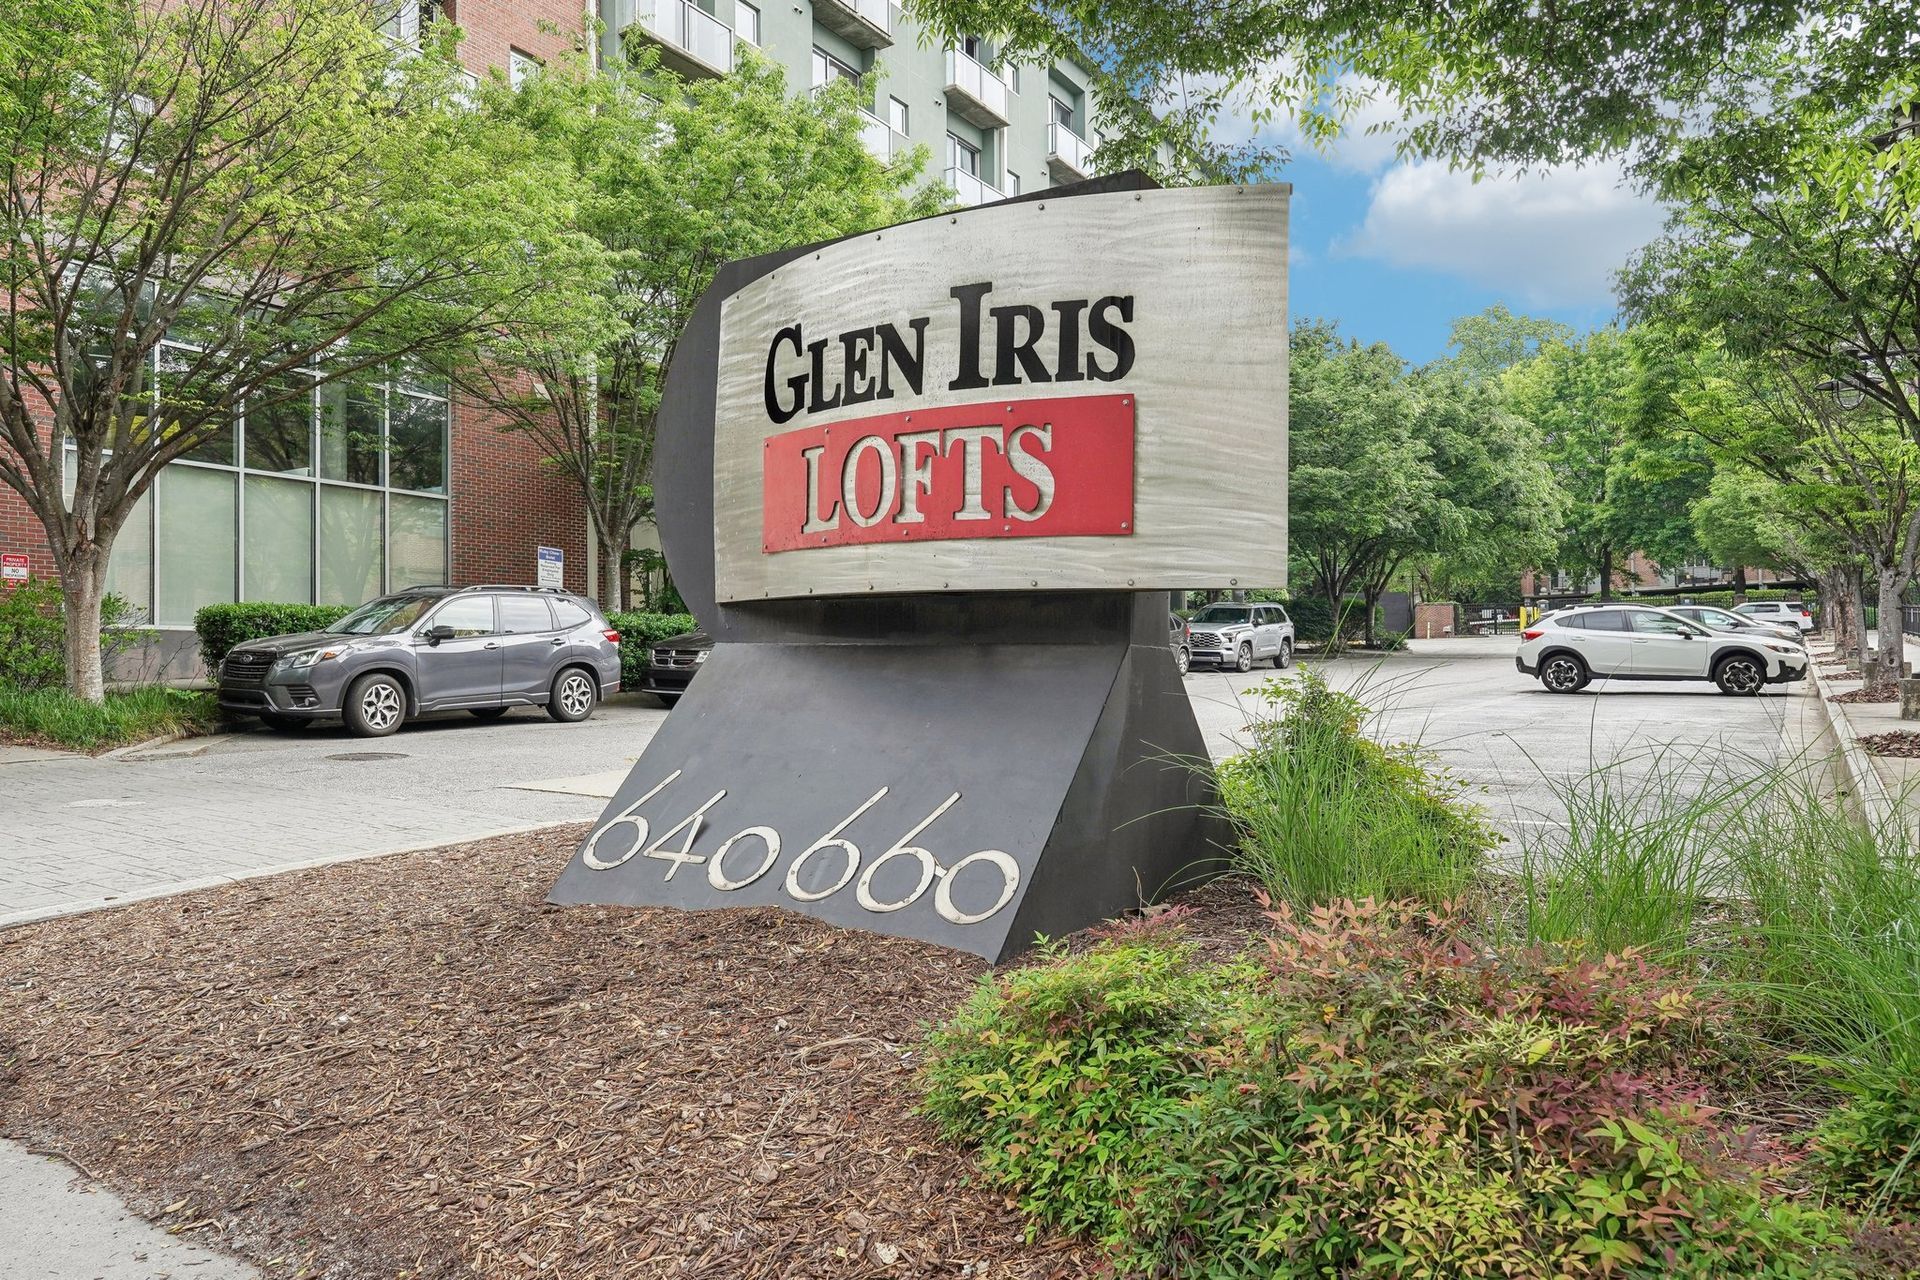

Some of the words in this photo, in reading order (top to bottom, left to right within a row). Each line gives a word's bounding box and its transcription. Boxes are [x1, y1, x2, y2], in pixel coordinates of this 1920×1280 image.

[764, 317, 929, 424] GLEN
[949, 282, 1136, 391] IRIS
[801, 423, 1055, 534] LOFTS
